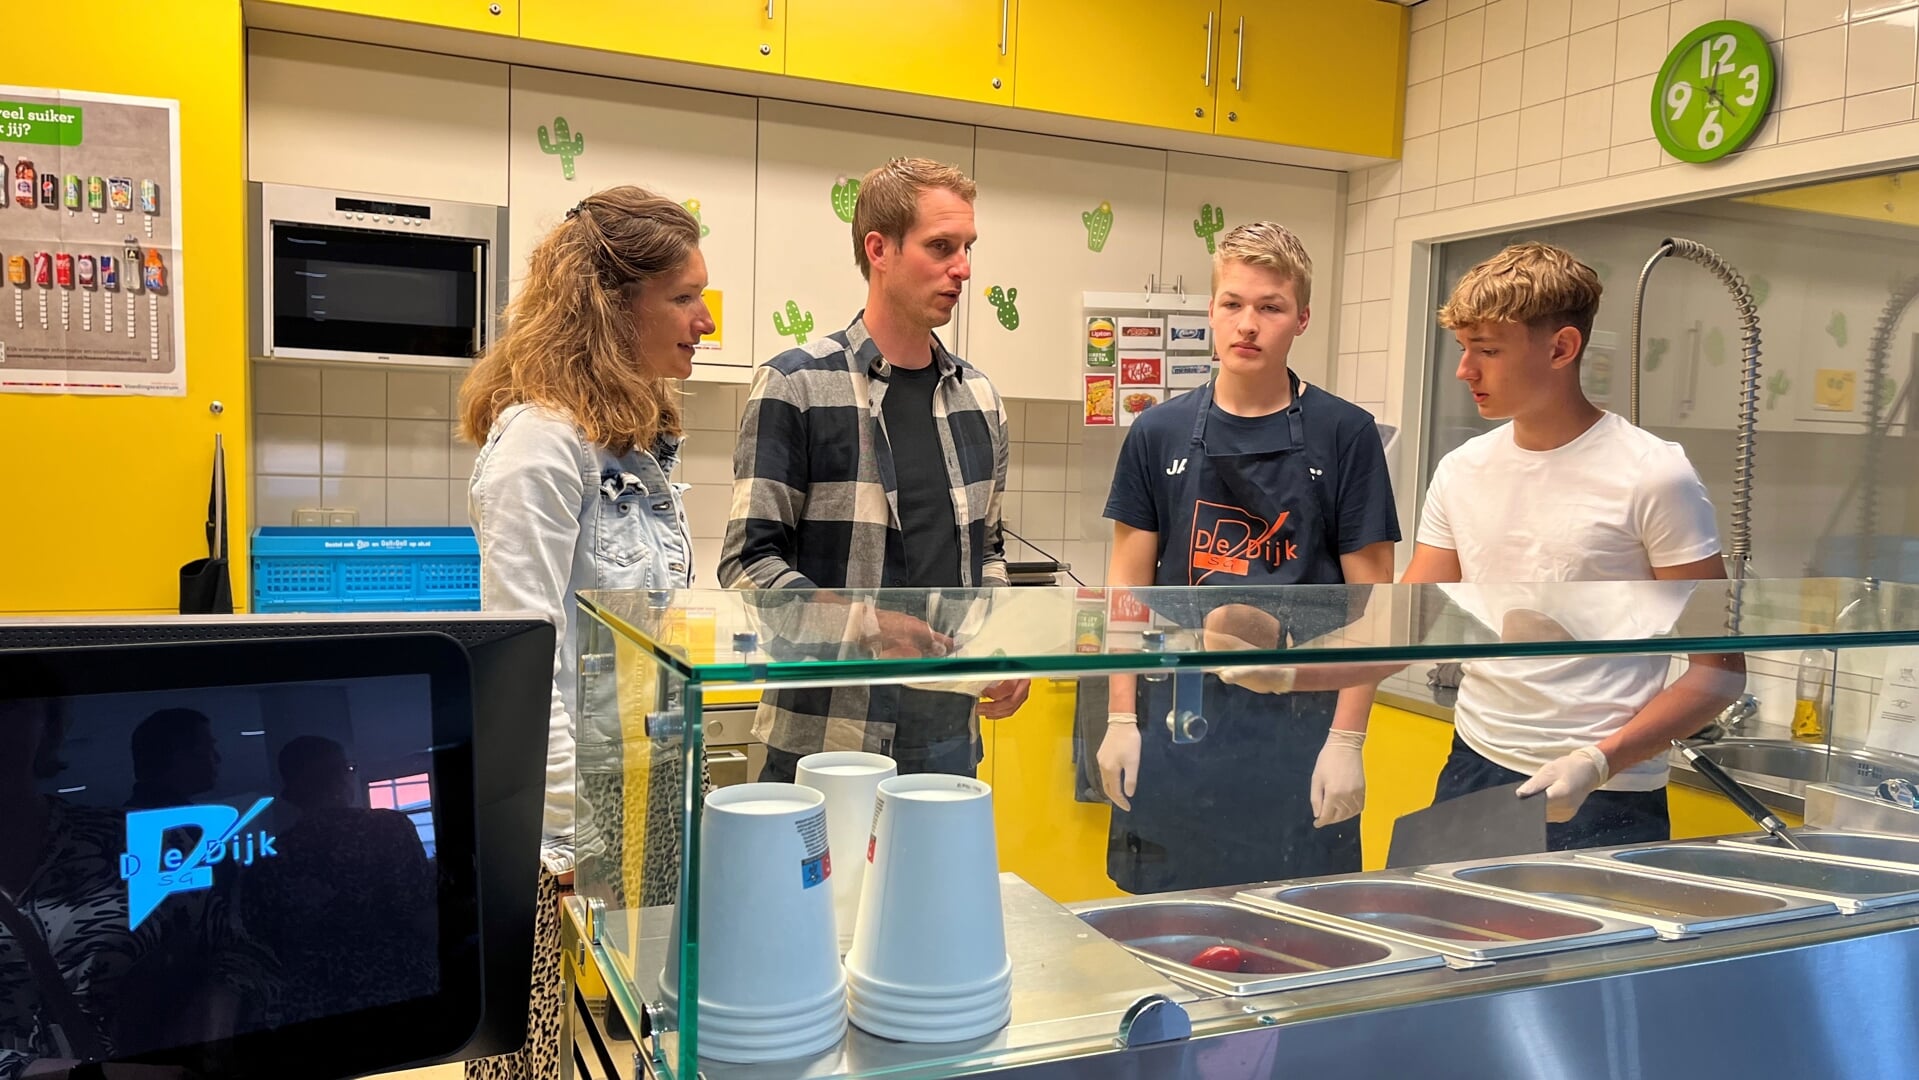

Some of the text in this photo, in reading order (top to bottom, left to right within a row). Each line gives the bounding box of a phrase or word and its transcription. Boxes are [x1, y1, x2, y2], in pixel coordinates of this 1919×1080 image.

[1700, 34, 1737, 79] 12
[1667, 81, 1693, 121] 9
[1736, 64, 1759, 107] 3
[6, 122, 31, 137] jij?
[28, 109, 75, 123] suiker
[1697, 109, 1724, 150] 6
[1195, 529, 1298, 567] De Dijk
[120, 831, 278, 880] De Dijk
